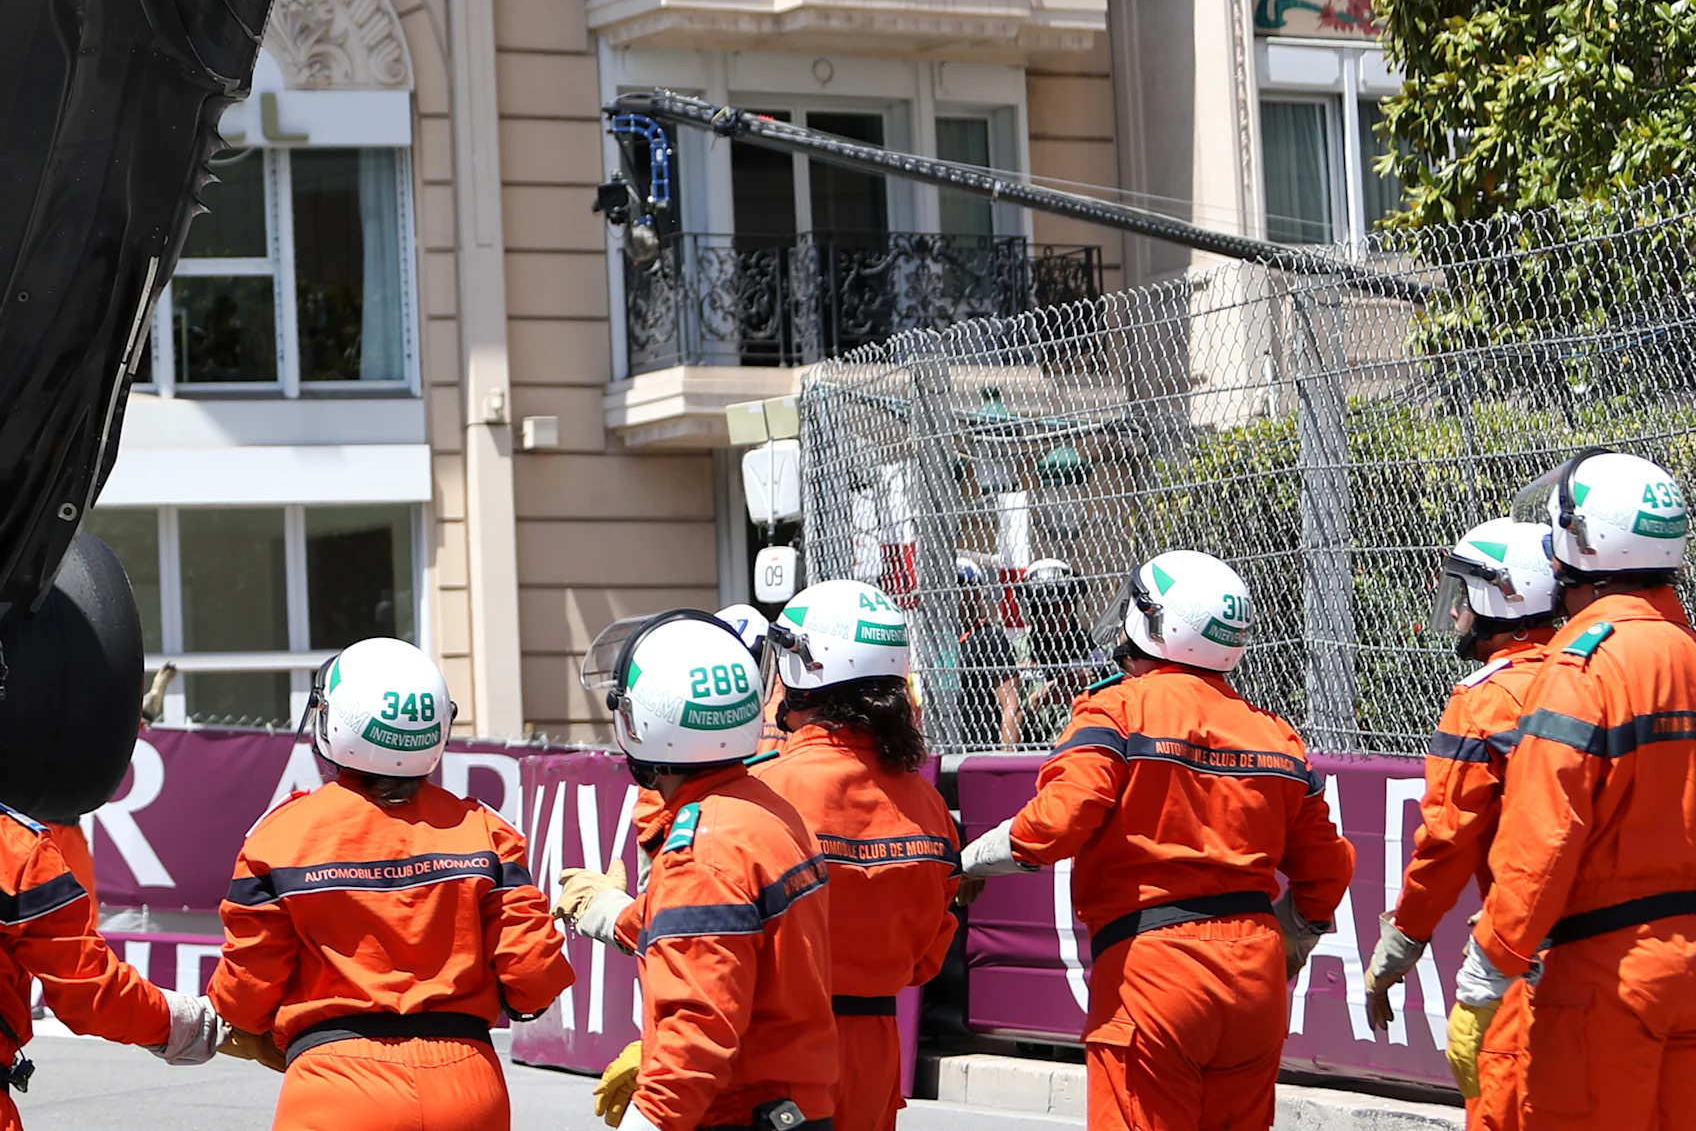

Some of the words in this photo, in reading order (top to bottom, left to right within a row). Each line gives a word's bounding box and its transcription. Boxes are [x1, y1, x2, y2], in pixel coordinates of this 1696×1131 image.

[765, 565, 783, 587] 09
[859, 591, 902, 614] 44
[689, 663, 750, 699] 288
[381, 691, 436, 722] 348
[687, 701, 760, 726] INTERVENTION
[369, 725, 439, 748] INTERVENTION
[1209, 752, 1236, 767] CLUB
[1240, 754, 1254, 767] DE
[1257, 754, 1295, 773] MONACO
[858, 842, 887, 860] CLUB
[890, 842, 903, 857] DE
[905, 841, 945, 857] MONACO
[305, 867, 381, 883] AUTOMOBILE
[384, 865, 413, 879] CLUB
[414, 860, 431, 874] DE
[433, 857, 490, 871] MONACO
